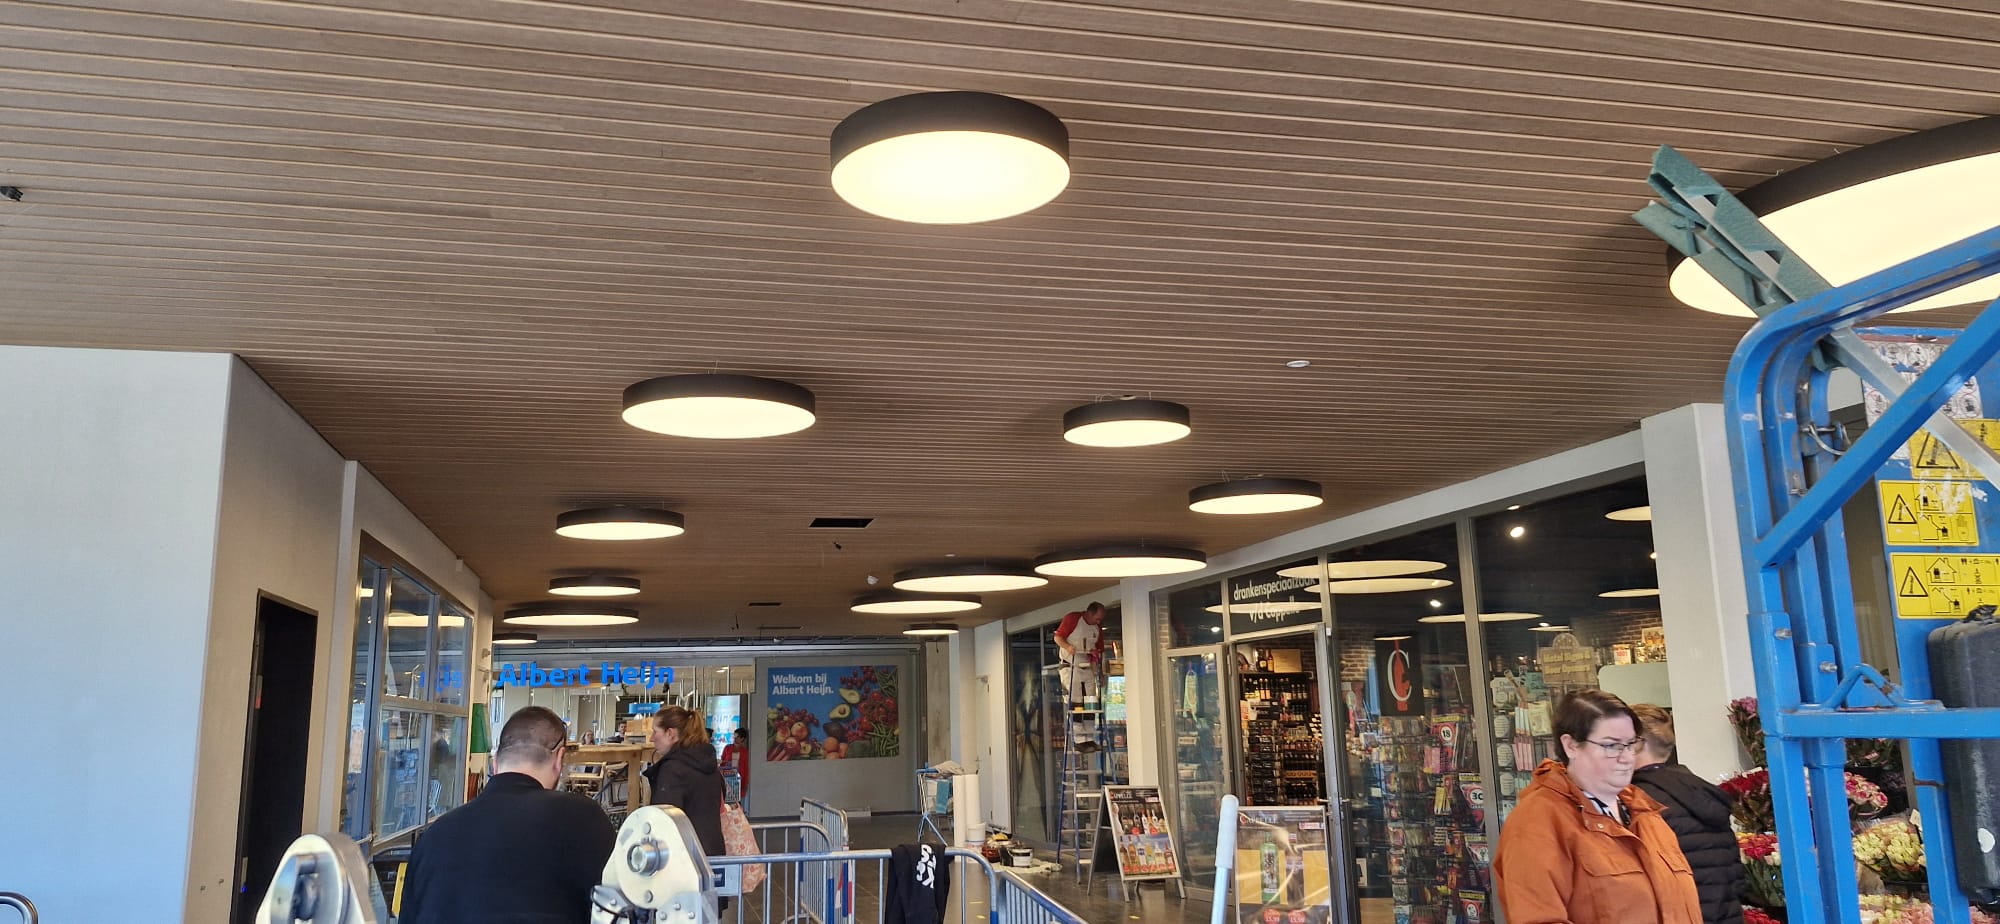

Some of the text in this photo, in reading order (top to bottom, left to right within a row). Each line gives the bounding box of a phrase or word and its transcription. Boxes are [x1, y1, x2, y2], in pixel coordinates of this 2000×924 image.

[496, 660, 675, 689] Albert Heijn
[772, 673, 827, 686] Welkom bij
[772, 684, 834, 696] Albert Heijn.
